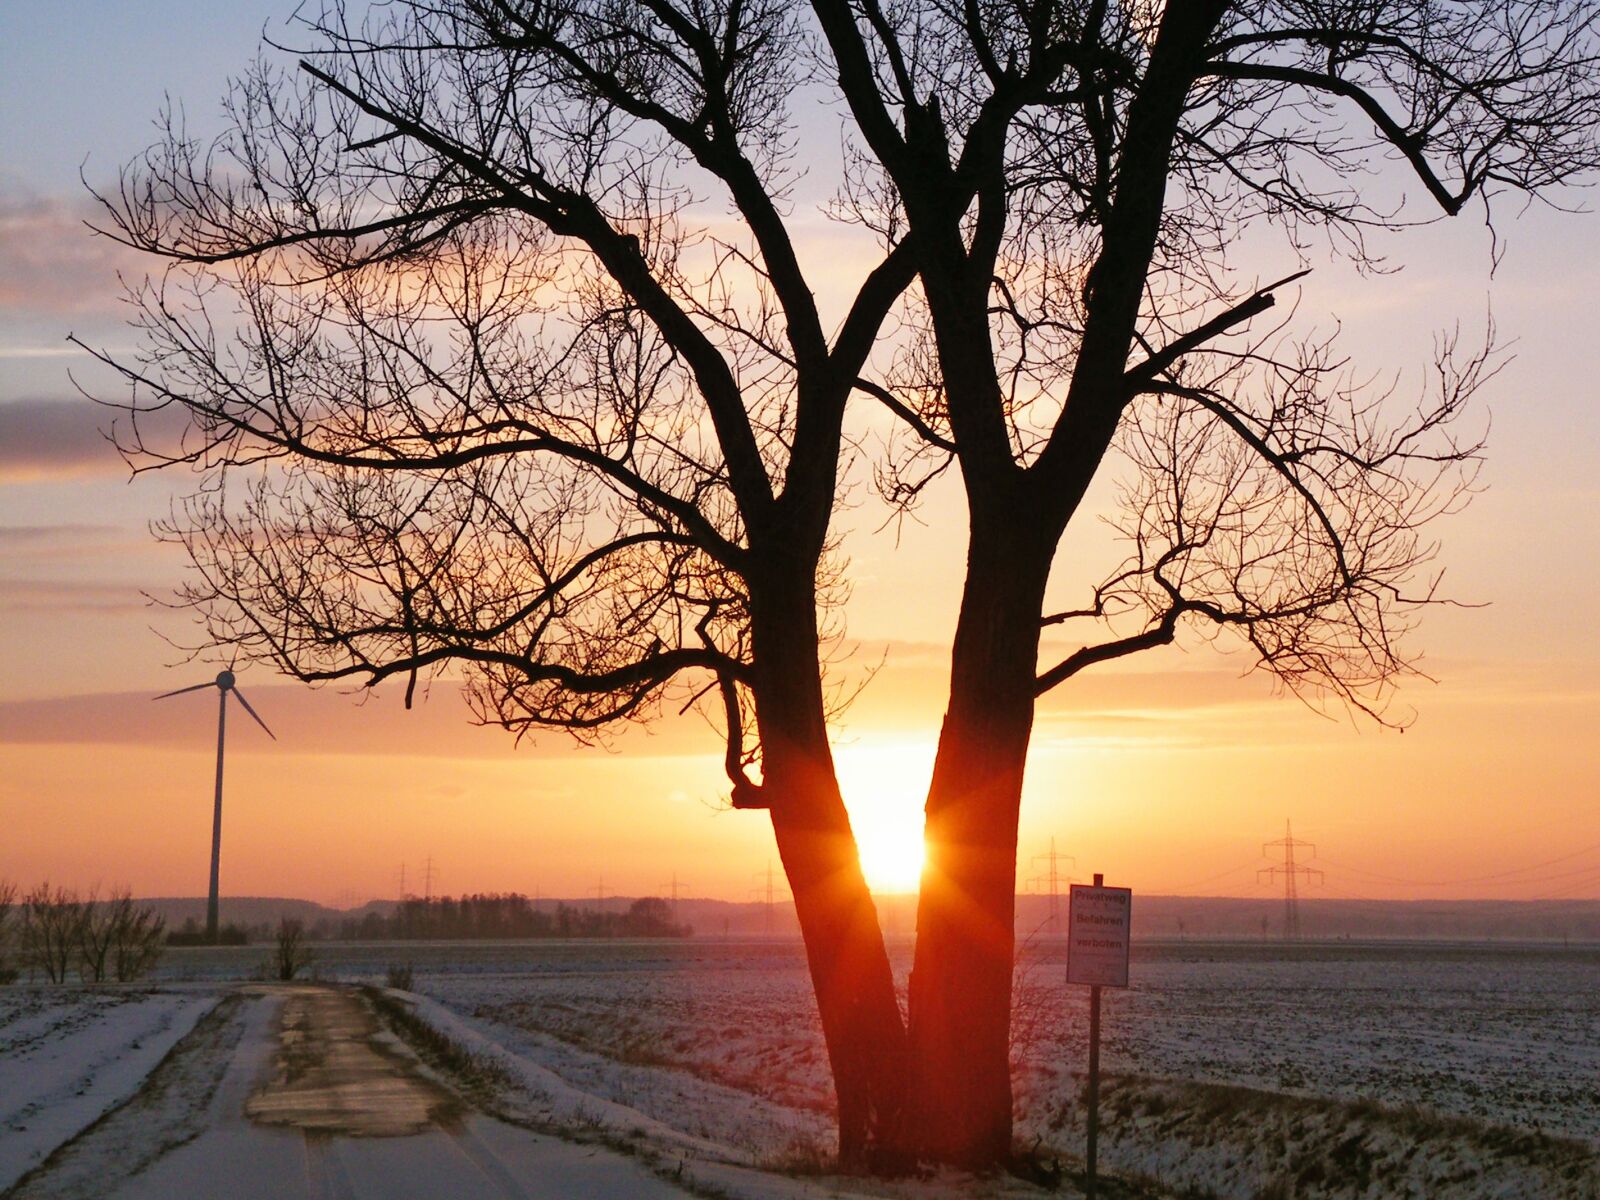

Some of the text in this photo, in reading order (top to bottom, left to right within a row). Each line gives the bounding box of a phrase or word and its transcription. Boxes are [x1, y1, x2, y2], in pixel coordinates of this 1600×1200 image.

[1075, 890, 1126, 904] Privatweg
[1077, 913, 1123, 926] Befahren
[1077, 938, 1122, 948] verboten
